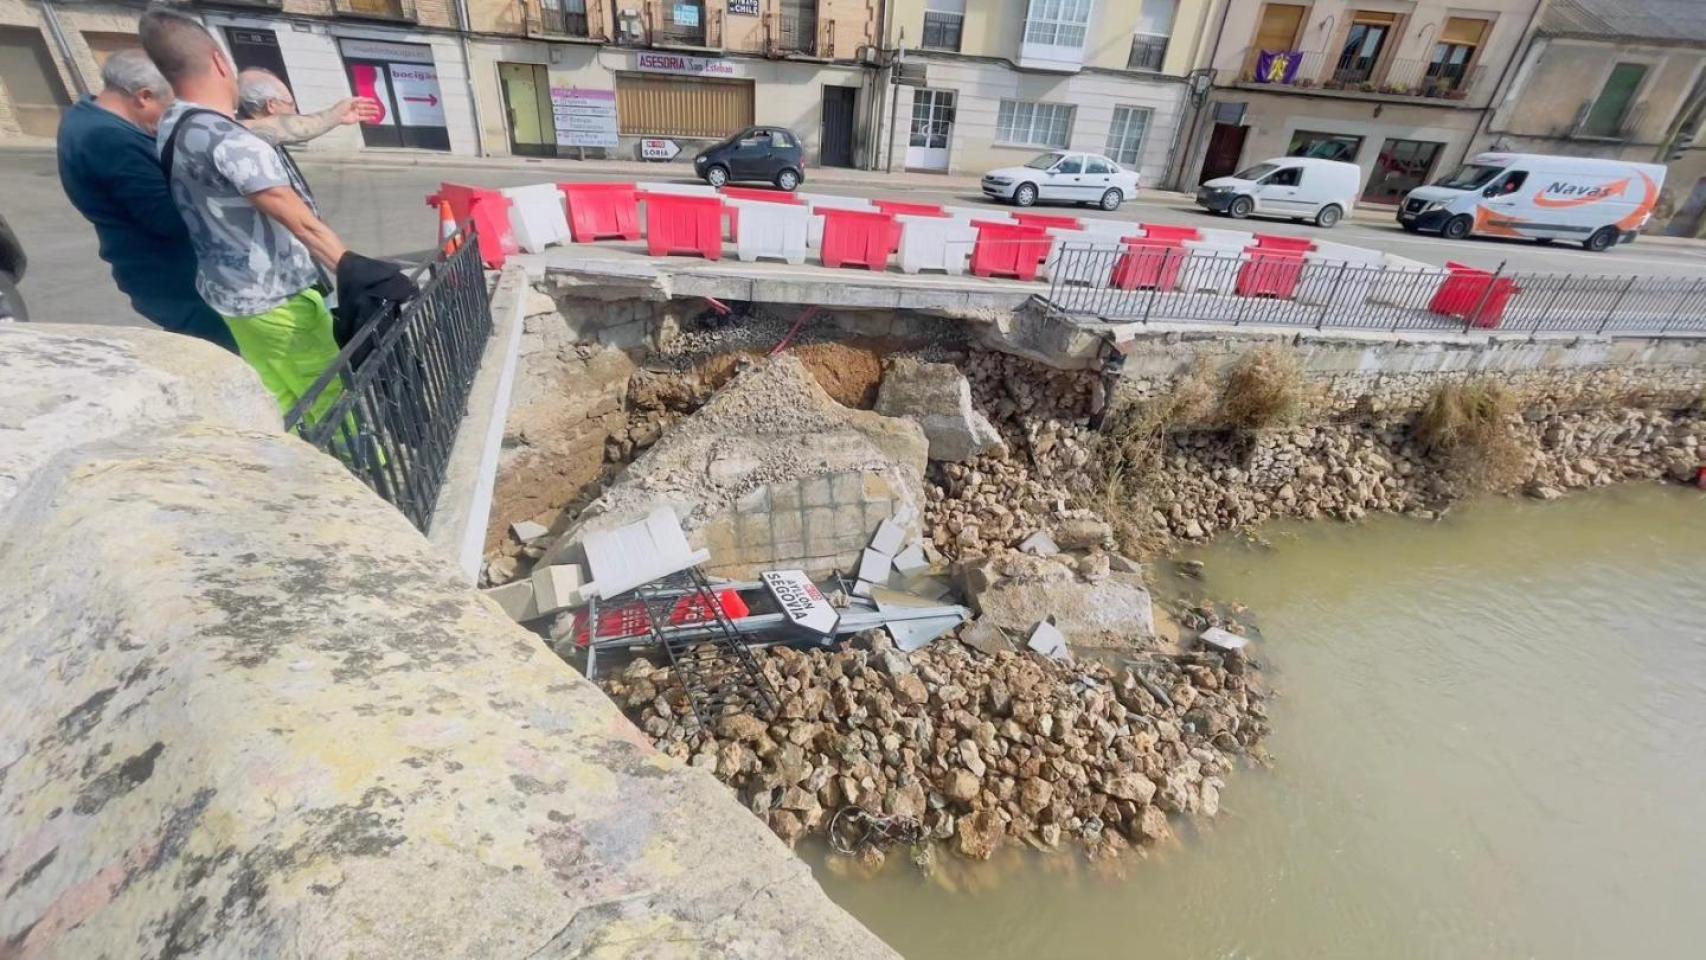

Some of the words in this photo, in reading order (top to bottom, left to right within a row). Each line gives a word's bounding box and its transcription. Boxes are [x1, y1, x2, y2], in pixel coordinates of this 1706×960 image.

[640, 55, 685, 70] ASESORIA
[705, 60, 733, 73] Esteban
[1546, 182, 1610, 198] Navas
[767, 573, 808, 620] SEGOVIA
